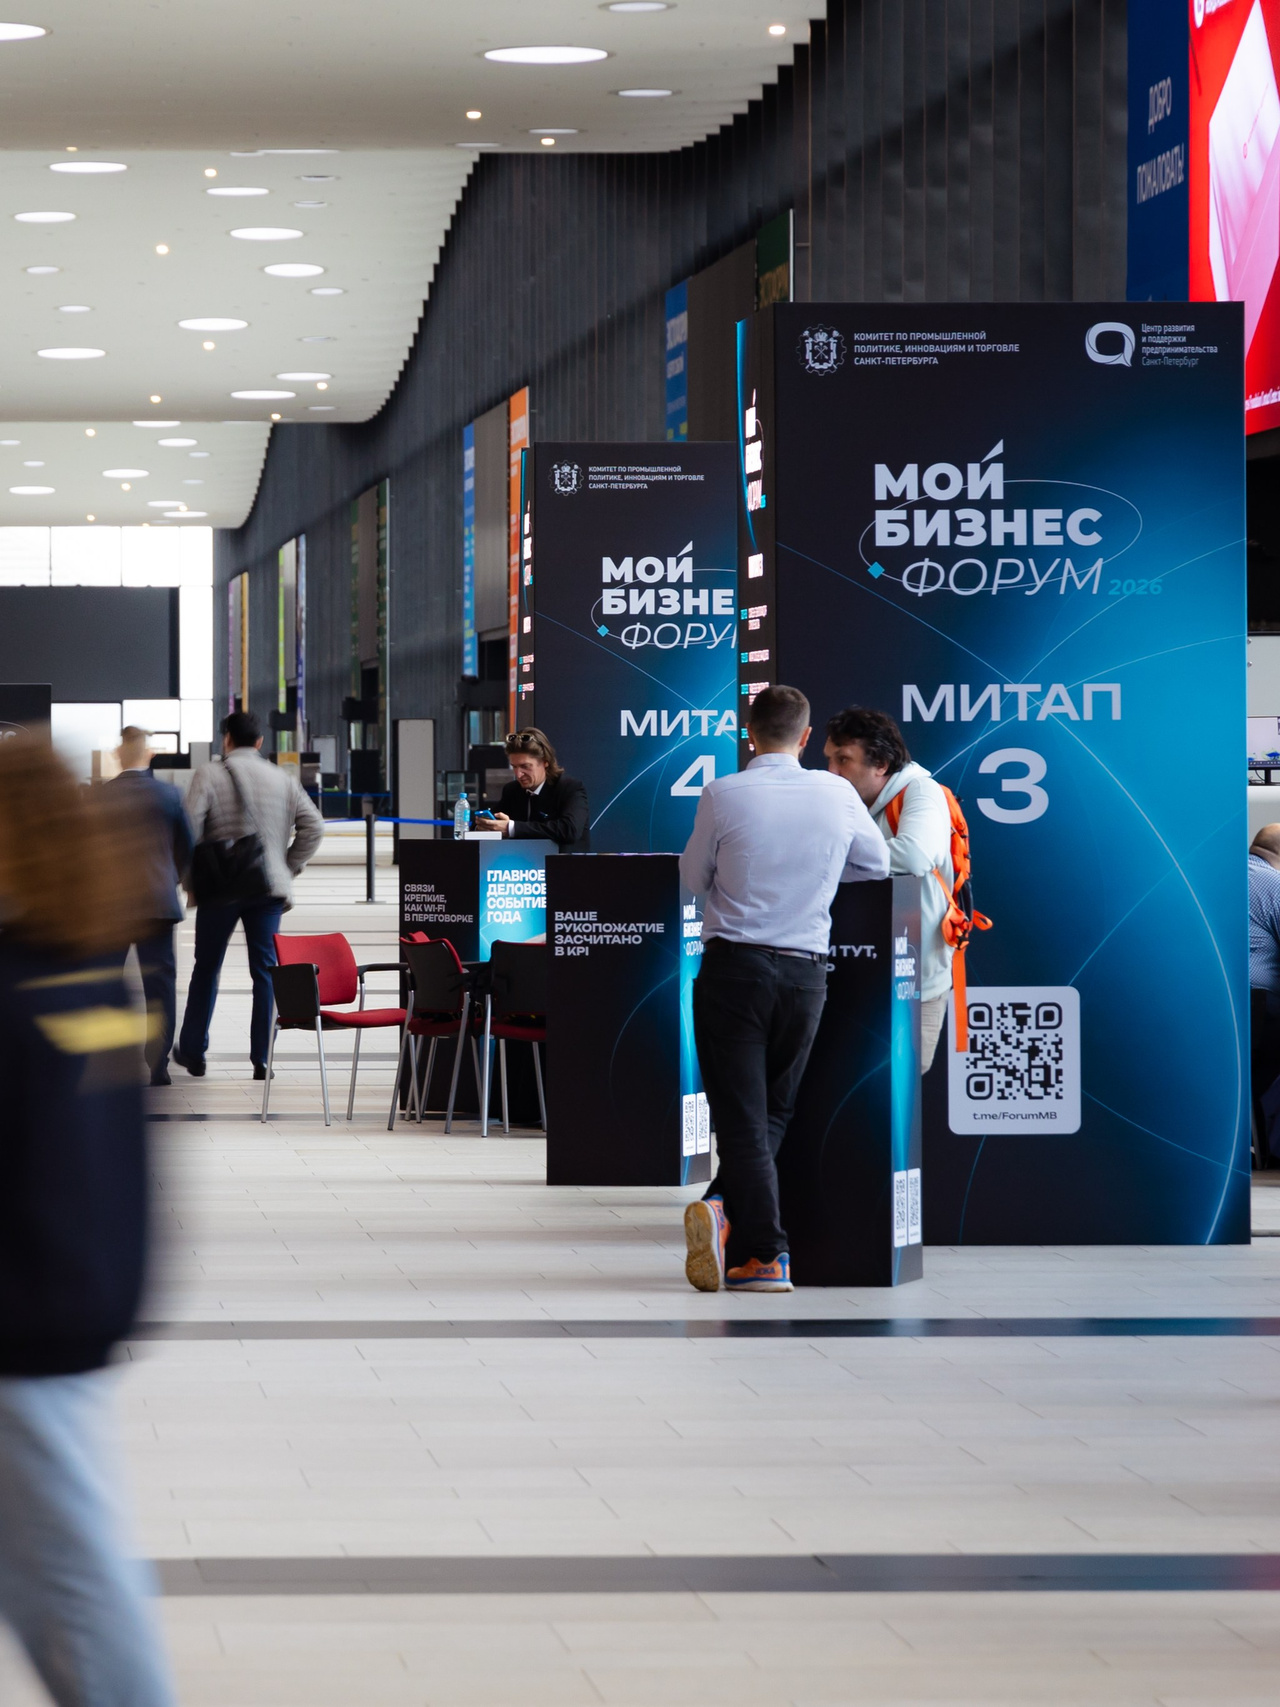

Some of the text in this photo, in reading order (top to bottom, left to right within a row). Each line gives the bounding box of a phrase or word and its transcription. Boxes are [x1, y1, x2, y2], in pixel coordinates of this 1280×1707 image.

[1148, 76, 1172, 135] ДОБРО
[1141, 323, 1195, 333] Центр развития
[853, 331, 987, 341] КОМИТЕТ ПО ПРОМЫШЛЕННОЙ
[1147, 336, 1187, 344] поддержки
[854, 344, 1020, 354] ПОЛИТИКЕ, ИННОВАЦИЯМ И ТОРГОВЛЕ
[1141, 346, 1218, 356] предпринимательства
[854, 357, 939, 365] САНКТ-ПЕТЕРБУРГА
[1141, 356, 1199, 367] Санкт-Петербург
[874, 438, 1004, 501] МОЙ
[875, 507, 1103, 546] БИЗНЕС
[602, 540, 693, 583] МОЙ
[902, 557, 1163, 597] ФОРУМ 2026
[602, 588, 735, 615] БИЗНЕ
[620, 622, 737, 650] ФОРУ
[902, 683, 1122, 722] МИТАП
[621, 709, 737, 736] МИТА
[670, 755, 716, 797] 4
[976, 747, 1050, 824] 3
[487, 869, 546, 882] ГЛАВНОЕ
[404, 884, 435, 893] СВЯЗИ
[486, 883, 547, 898] ДЕЛОВОЕ
[404, 894, 447, 904] КРЕПКИЕ,
[486, 897, 547, 910] СОБЫТИЕ
[404, 904, 446, 913] КАК WI-FI
[404, 914, 474, 923] В ПЕРЕГОВОРКЕ
[487, 911, 522, 925] ГОДА
[554, 911, 597, 922] ВАШЕ
[554, 923, 665, 934] РУКОПОЖАТИЕ
[554, 934, 642, 945] ЗАСЧИТАНО
[554, 946, 589, 956] В KPI
[839, 945, 878, 959] ТУТ,
[973, 1111, 1058, 1120] t.me/ForumMB
